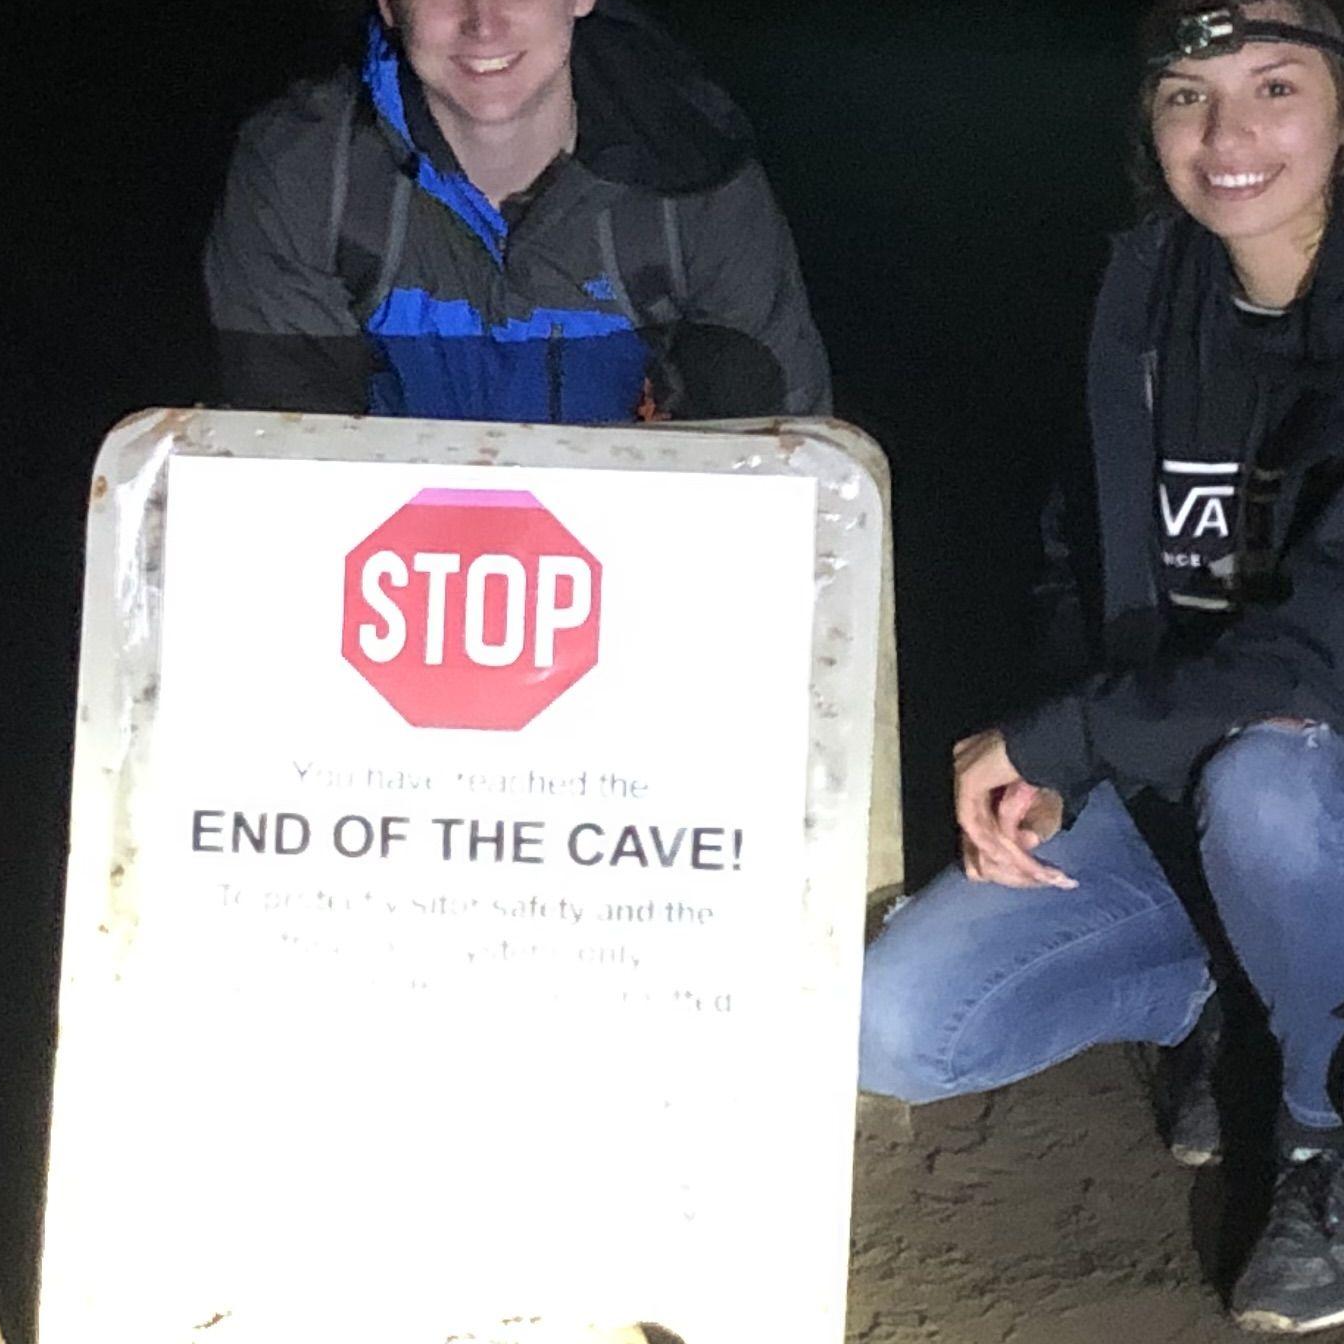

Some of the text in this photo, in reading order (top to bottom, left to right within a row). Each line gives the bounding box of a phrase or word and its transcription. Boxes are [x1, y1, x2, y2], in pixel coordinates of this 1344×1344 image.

[359, 550, 592, 668] STOP
[367, 766, 433, 792] have
[598, 771, 650, 800] the
[191, 809, 744, 872] END OF THE CAVE!
[597, 899, 655, 923] and
[664, 900, 716, 926] the
